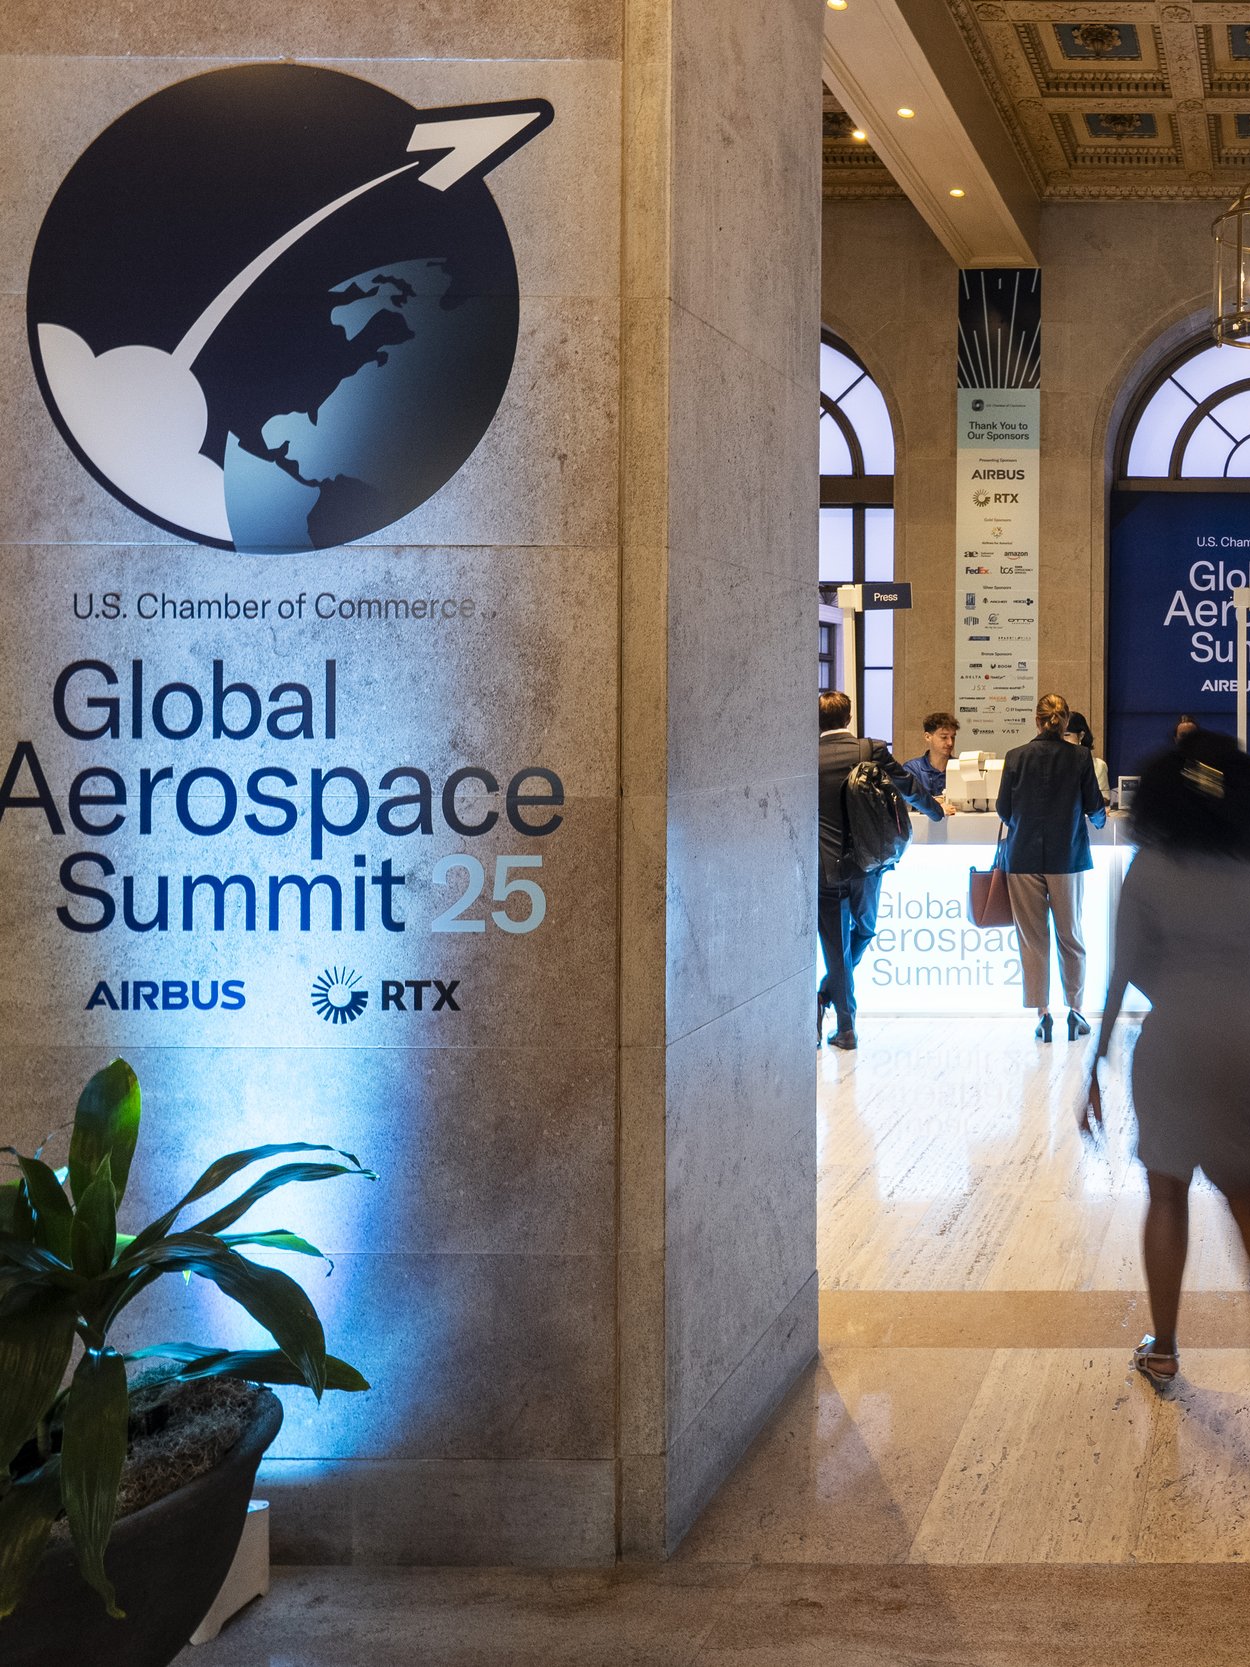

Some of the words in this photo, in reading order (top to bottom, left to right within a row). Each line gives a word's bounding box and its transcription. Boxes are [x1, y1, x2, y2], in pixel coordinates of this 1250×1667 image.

[967, 431, 984, 440] Our
[987, 431, 1030, 441] Sponsors
[969, 421, 998, 430] Thank
[1000, 421, 1017, 430] You
[1018, 422, 1028, 430] to
[971, 470, 1025, 480] AIRBUS
[994, 493, 1018, 503] RTX
[1196, 537, 1218, 548] U.S.
[73, 593, 127, 620] U.S.
[137, 592, 271, 620] Chamber
[277, 592, 307, 620] of
[314, 592, 477, 620] Commerce
[874, 592, 898, 602] Press
[53, 659, 336, 741] Global
[0, 741, 565, 860] Aerospace
[56, 851, 405, 934] Summit
[430, 854, 547, 934] 25
[872, 958, 994, 986] Summit
[85, 980, 246, 1011] AIRBUS
[381, 980, 461, 1011] RTX
